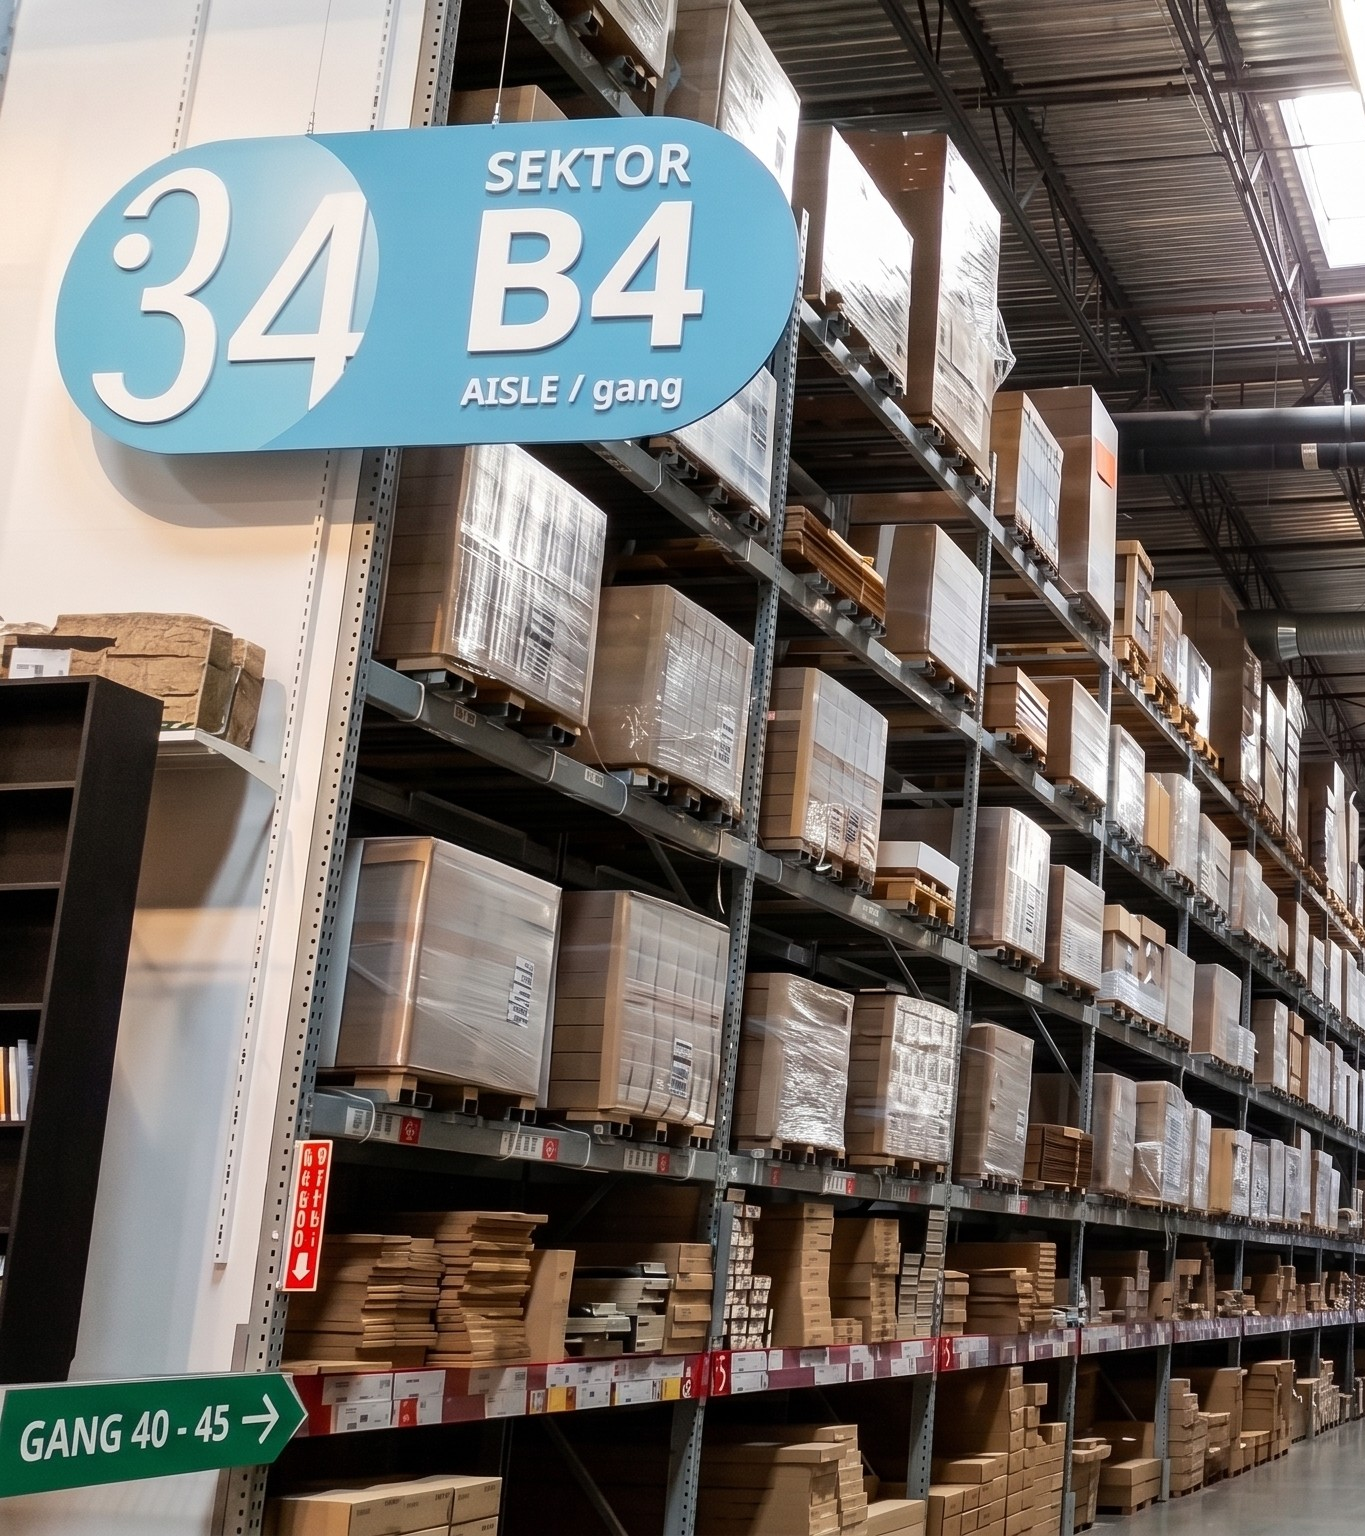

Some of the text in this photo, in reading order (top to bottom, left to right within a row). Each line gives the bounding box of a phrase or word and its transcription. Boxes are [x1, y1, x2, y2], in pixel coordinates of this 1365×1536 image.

[485, 143, 691, 192] SEKTOR
[92, 167, 367, 424] 34
[467, 200, 704, 354] B4
[460, 374, 682, 410] AISLE / gang
[20, 1404, 230, 1462] GANG 40 - 45
